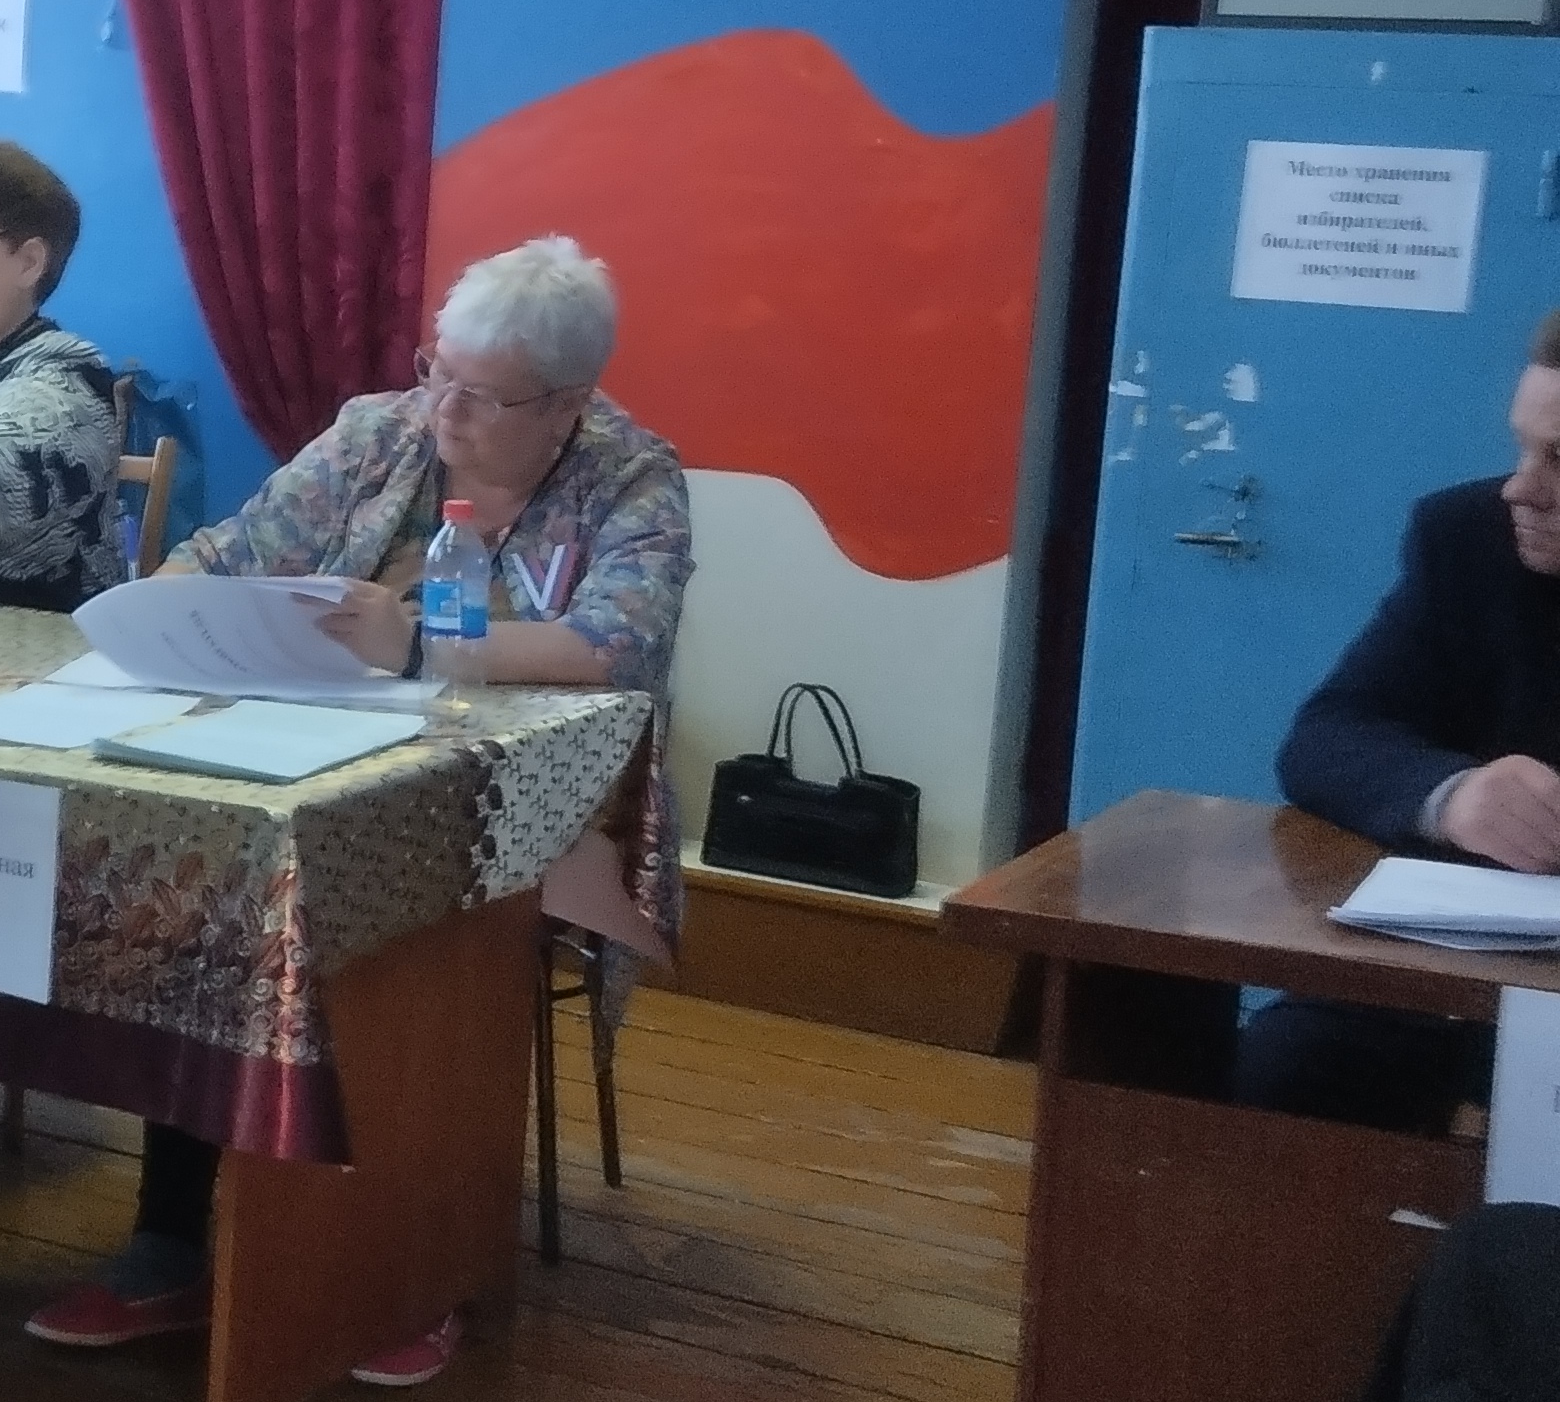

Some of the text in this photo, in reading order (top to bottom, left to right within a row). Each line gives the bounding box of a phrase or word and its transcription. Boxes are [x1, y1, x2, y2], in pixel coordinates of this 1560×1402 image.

[1288, 160, 1452, 183] Место хранения
[1329, 190, 1401, 206] списка
[1260, 232, 1460, 259] бюллетеней и иных
[1300, 262, 1417, 282] документов
